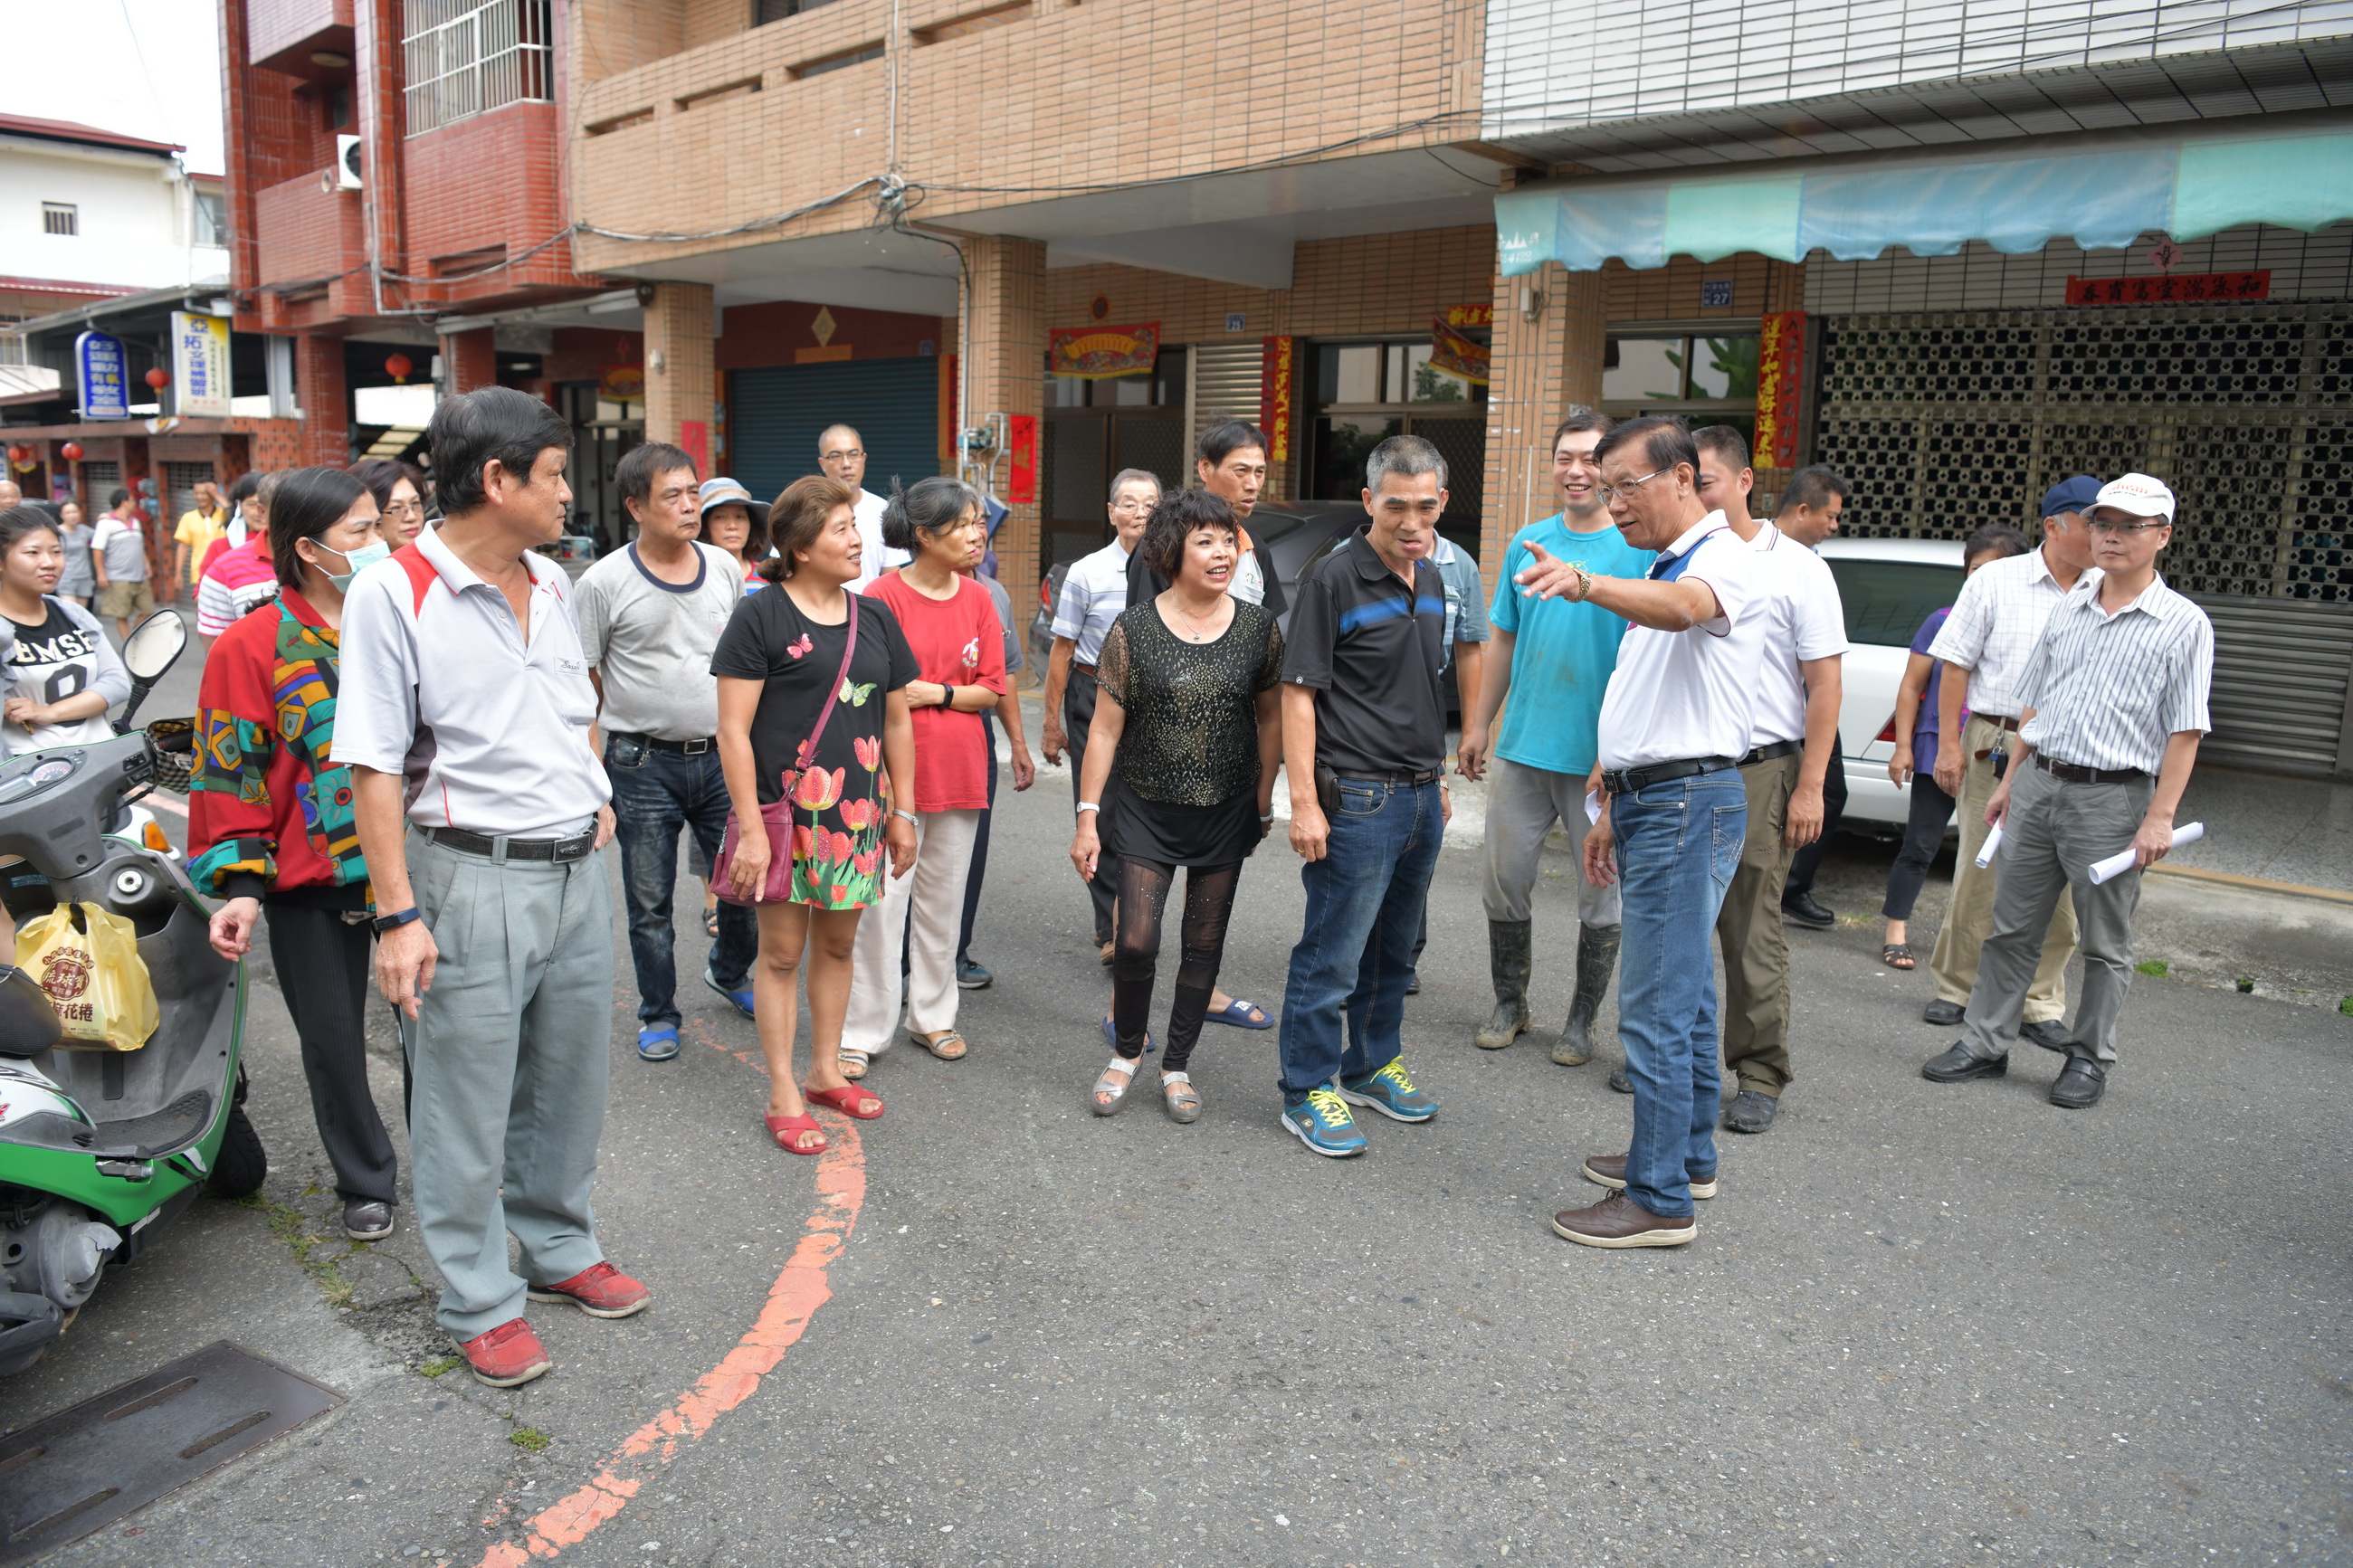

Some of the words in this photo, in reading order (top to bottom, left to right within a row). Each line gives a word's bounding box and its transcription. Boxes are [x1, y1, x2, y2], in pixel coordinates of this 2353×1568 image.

[1712, 293, 1729, 305] 27
[49, 1001, 93, 1022] 麻花捲
